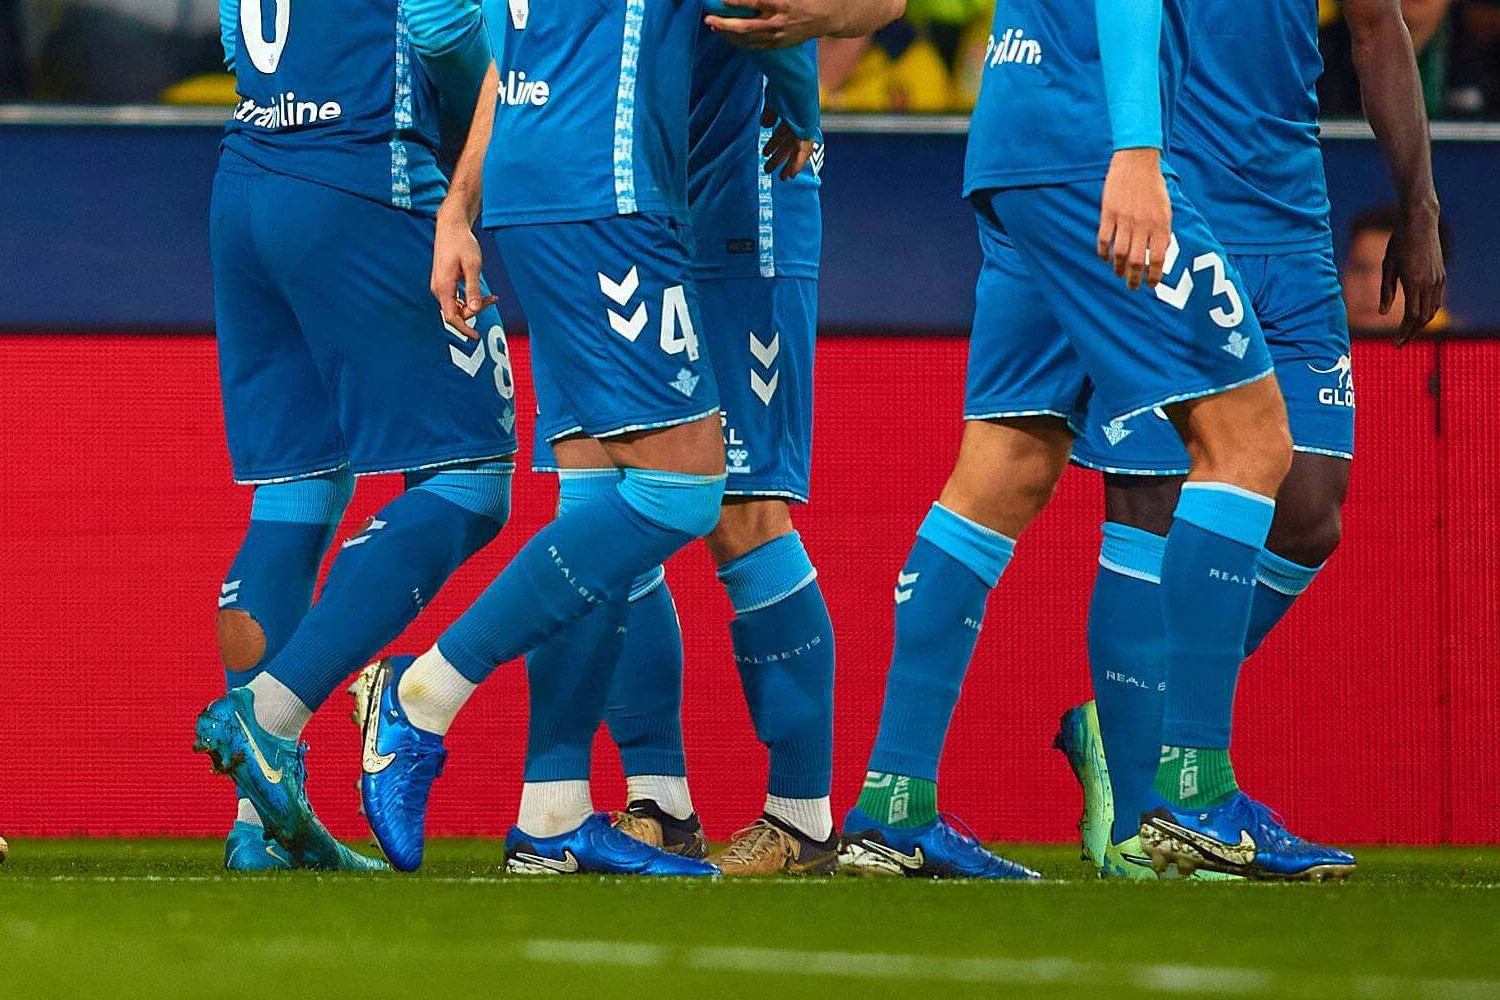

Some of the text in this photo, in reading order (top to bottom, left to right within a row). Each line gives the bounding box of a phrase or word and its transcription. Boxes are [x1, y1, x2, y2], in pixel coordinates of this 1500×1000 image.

[660, 284, 700, 362] 4
[1193, 251, 1244, 328] 3
[488, 324, 515, 400] 8
